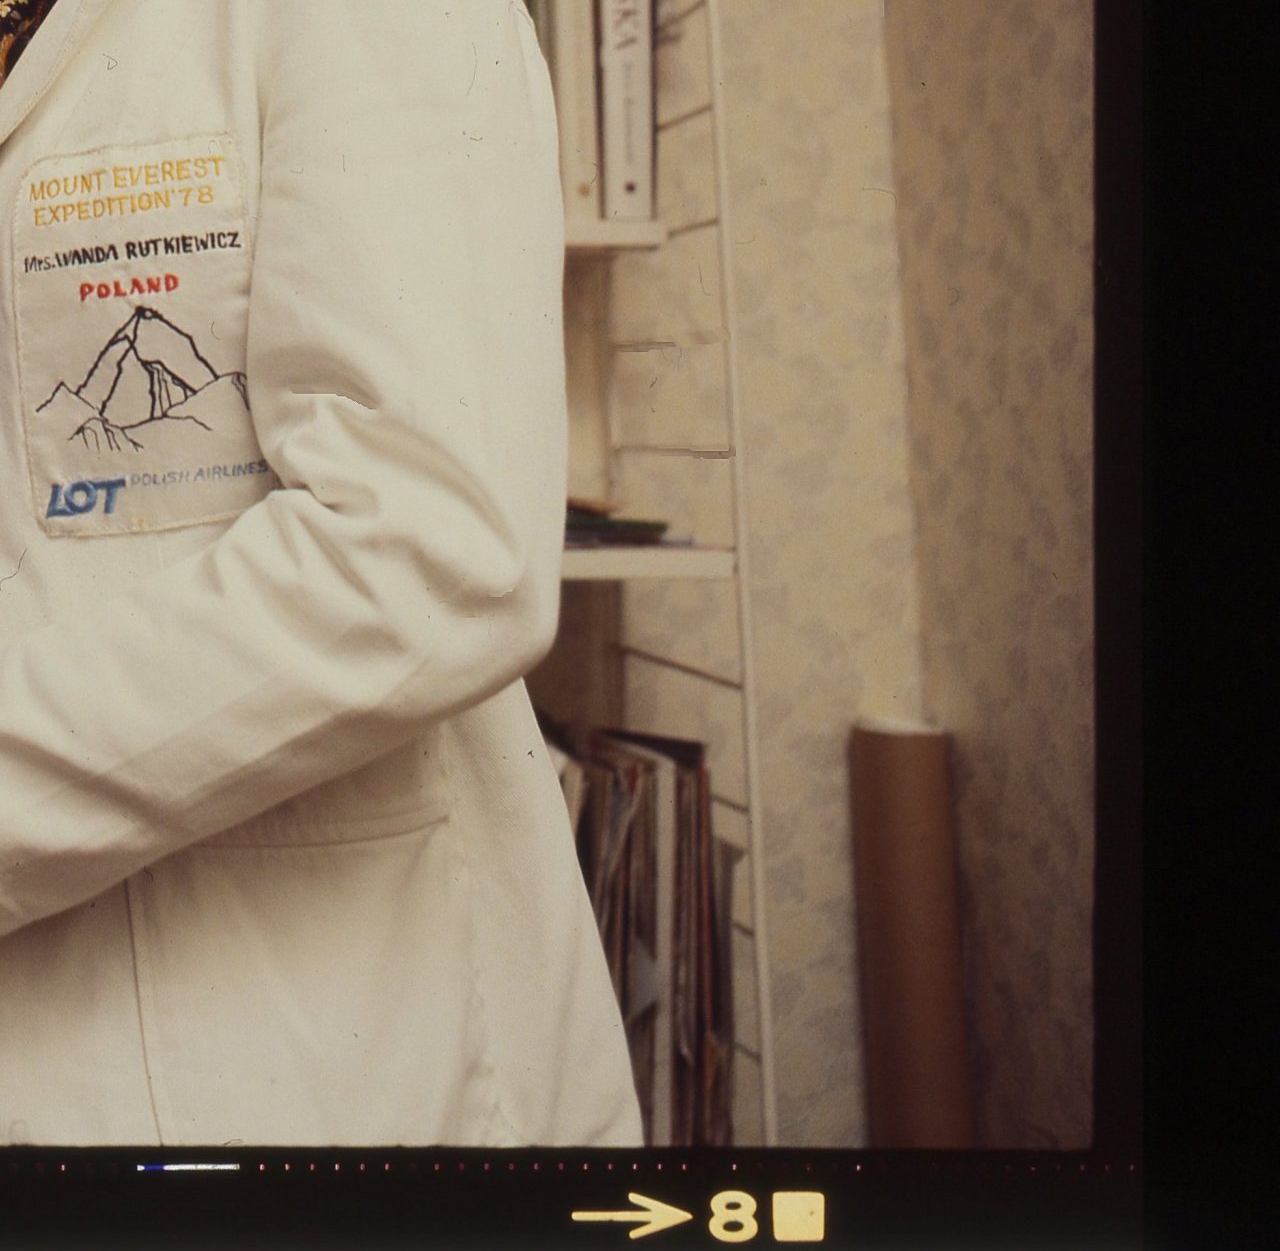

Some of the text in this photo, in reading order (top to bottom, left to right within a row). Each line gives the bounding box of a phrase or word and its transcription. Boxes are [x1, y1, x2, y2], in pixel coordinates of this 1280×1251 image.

[29, 157, 225, 202] MOUNT EVEREST
[125, 231, 241, 260] RUTKIEWICZ
[79, 273, 180, 302] POLAND
[46, 459, 269, 519] LOT POLISH AIRLINES
[708, 1190, 759, 1242] 8
